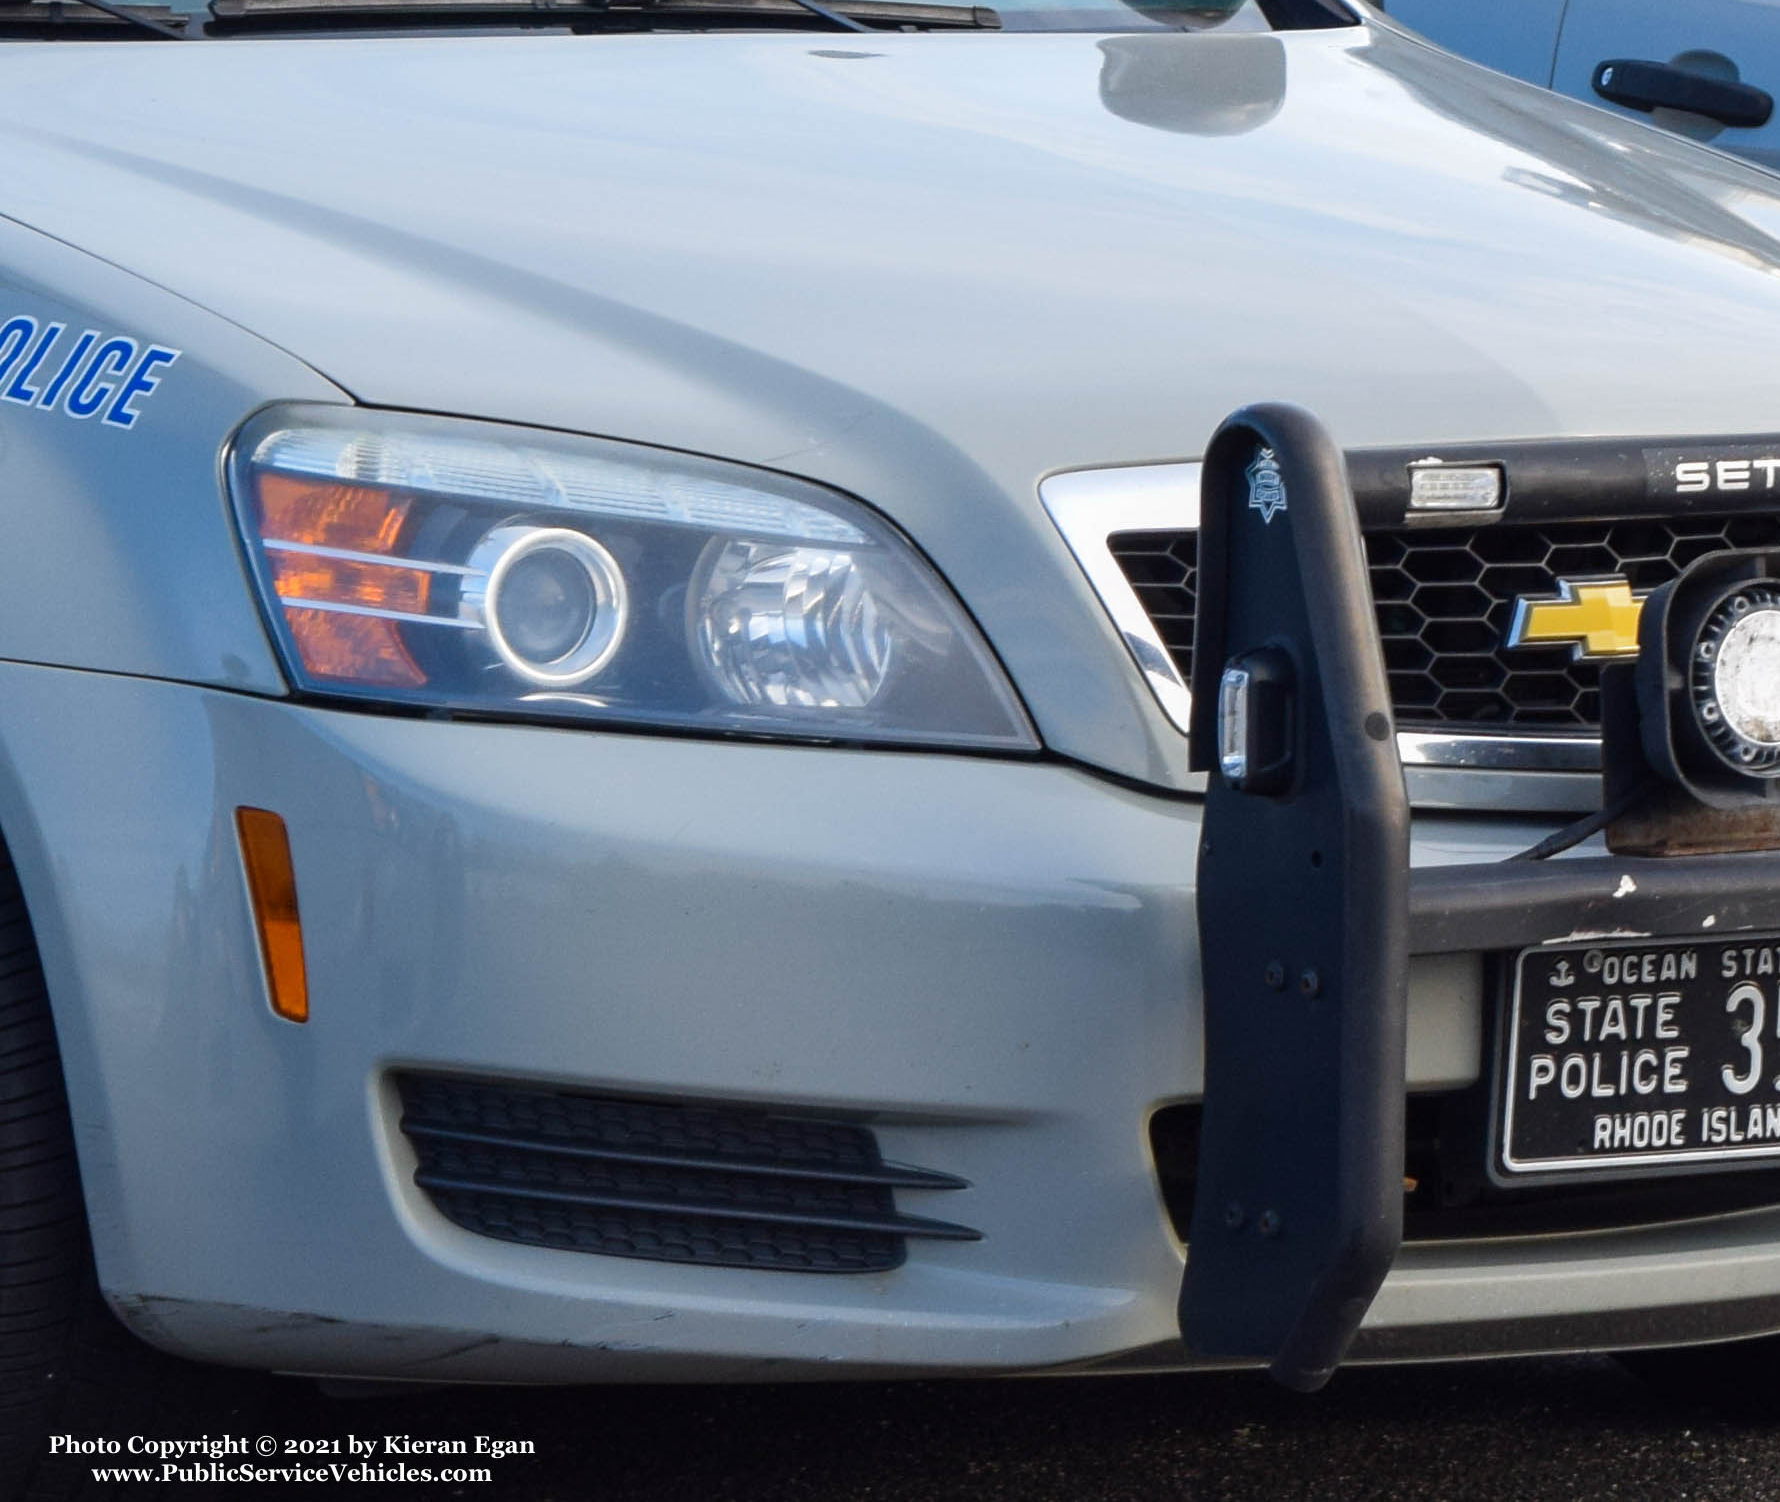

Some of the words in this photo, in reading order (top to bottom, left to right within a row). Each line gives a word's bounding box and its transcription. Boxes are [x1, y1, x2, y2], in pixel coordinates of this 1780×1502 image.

[1602, 949, 1697, 985] OCEAN
[1544, 991, 1683, 1044] STATE
[1528, 1046, 1690, 1100] POLICE
[1594, 1109, 1687, 1149] RHODE
